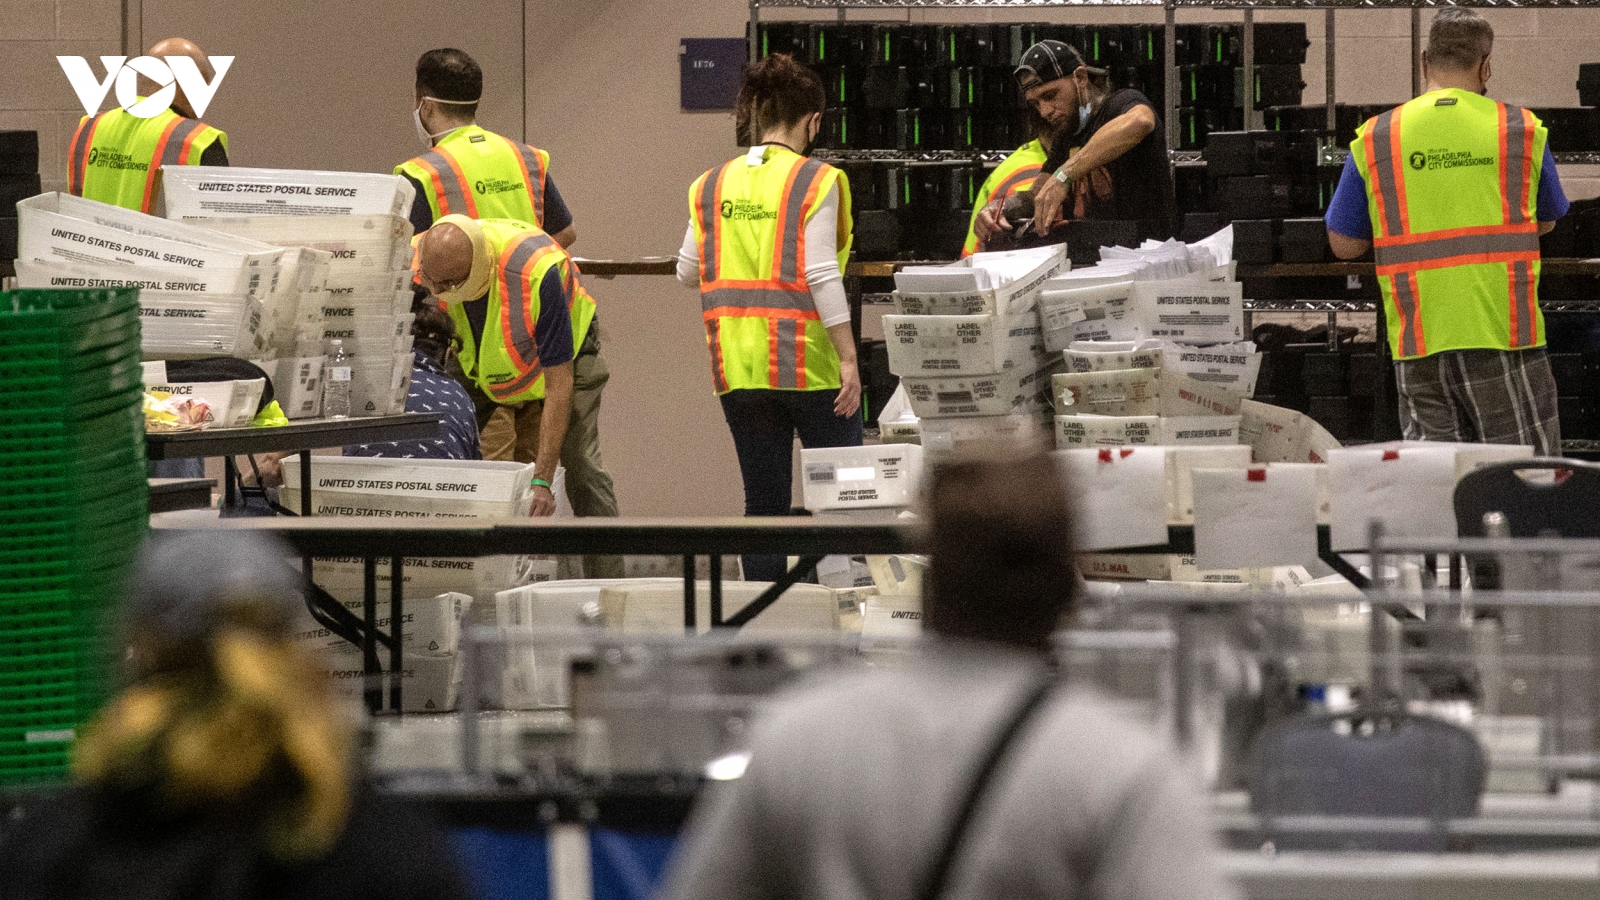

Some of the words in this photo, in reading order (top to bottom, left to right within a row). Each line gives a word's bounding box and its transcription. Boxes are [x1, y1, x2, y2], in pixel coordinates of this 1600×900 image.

[1427, 151, 1473, 162] PHILADELPHIA
[1428, 161, 1443, 170] CITY
[198, 182, 235, 192] UNITED
[236, 184, 273, 194] STATES
[274, 185, 312, 196] POSTAL
[314, 187, 358, 198] SERVICE
[51, 228, 86, 243] UNITED
[87, 236, 122, 252] STATES
[123, 245, 161, 260] POSTAL
[162, 253, 206, 268] SERVICE
[51, 277, 86, 288] UNITED
[87, 278, 123, 289] STATES
[125, 280, 163, 290] POSTAL
[164, 281, 207, 292] SERVICE
[137, 308, 162, 318] STAL
[163, 309, 207, 319] SERVICE
[321, 306, 355, 317] RVICE
[956, 322, 981, 330] LABEL
[323, 330, 355, 339] RVICE
[1072, 356, 1090, 364] LABEL
[1130, 354, 1151, 362] LABEL
[1130, 361, 1154, 369] OTHER
[972, 380, 994, 388] LABEL
[973, 386, 997, 394] OTHER
[1125, 422, 1149, 430] LABEL
[1063, 429, 1086, 437] OTHER
[1125, 429, 1150, 437] OTHER
[1068, 436, 1082, 444] END
[318, 478, 355, 488] UNITED
[356, 479, 393, 490] STATES
[394, 481, 433, 491] POSTAL
[435, 482, 478, 493] SERVICE
[317, 505, 354, 516] UNITED
[355, 507, 392, 518] STATES
[352, 556, 390, 566] STES
[401, 557, 430, 568] STAL
[432, 558, 475, 570] SERVICE
[375, 613, 414, 628] SERCE
[891, 611, 922, 620] UNITED
[298, 628, 331, 641] TATES
